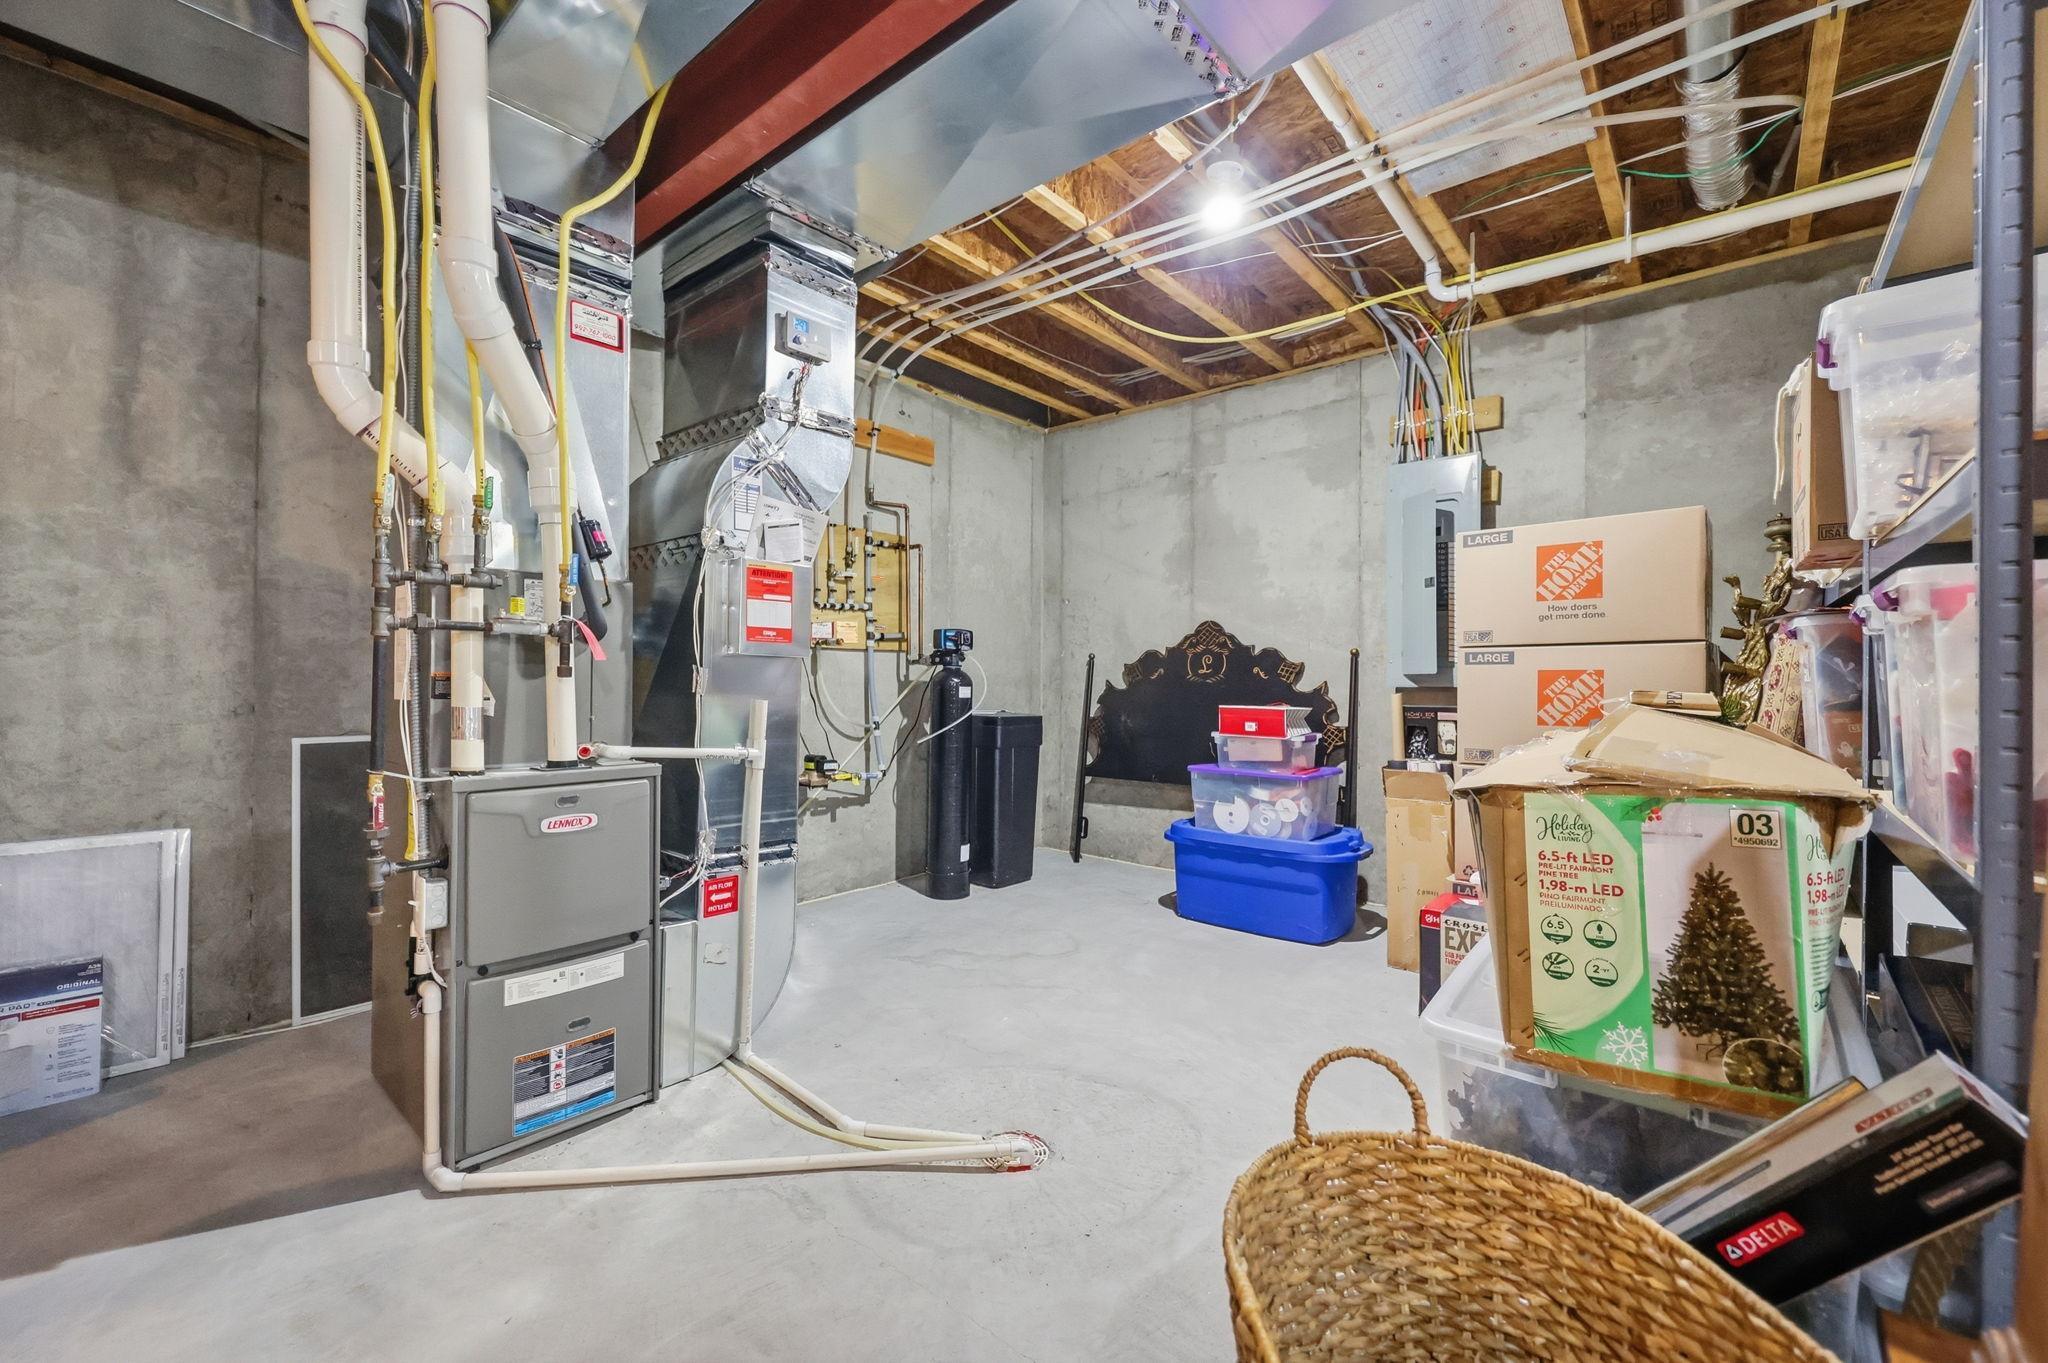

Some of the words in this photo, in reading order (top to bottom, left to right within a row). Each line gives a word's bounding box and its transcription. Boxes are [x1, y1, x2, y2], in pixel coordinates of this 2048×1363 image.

[1467, 533, 1508, 546] LARGE
[1820, 529, 1841, 539] USA
[1543, 549, 1570, 574] THE
[752, 569, 788, 579] ATTENTION!
[1536, 541, 1603, 601] HOME
[1562, 560, 1603, 600] DEPOT
[1548, 604, 1568, 612] How
[1570, 603, 1597, 611] doers
[1538, 613, 1553, 622] get
[1556, 612, 1579, 620] more
[1582, 611, 1606, 619] done
[1469, 653, 1510, 663] LARGE
[1543, 675, 1571, 698] THE
[1537, 669, 1604, 726] HOME
[1562, 690, 1604, 727] DEPOT
[547, 817, 584, 830] LENNOX
[1536, 813, 1594, 843] Holiday
[1736, 813, 1774, 837] 03
[1538, 850, 1578, 864] 6.5-ft
[1582, 853, 1614, 866] LED
[1538, 862, 1567, 871] PRE-LIT
[1569, 865, 1614, 874] FAIRMONT
[1538, 870, 1557, 878] PINE
[1559, 872, 1579, 880] TREE
[1807, 871, 1834, 886] 6.5-ft
[1834, 867, 1845, 882] LED
[718, 881, 733, 889] FLOW
[1592, 883, 1624, 897] LED
[1539, 900, 1604, 912] PREILUMINADO
[1561, 894, 1606, 905] FAIRMONT
[1546, 920, 1565, 930] 6.5
[57, 978, 101, 990] ORIGINAL
[1740, 1217, 1798, 1256] DELTA
